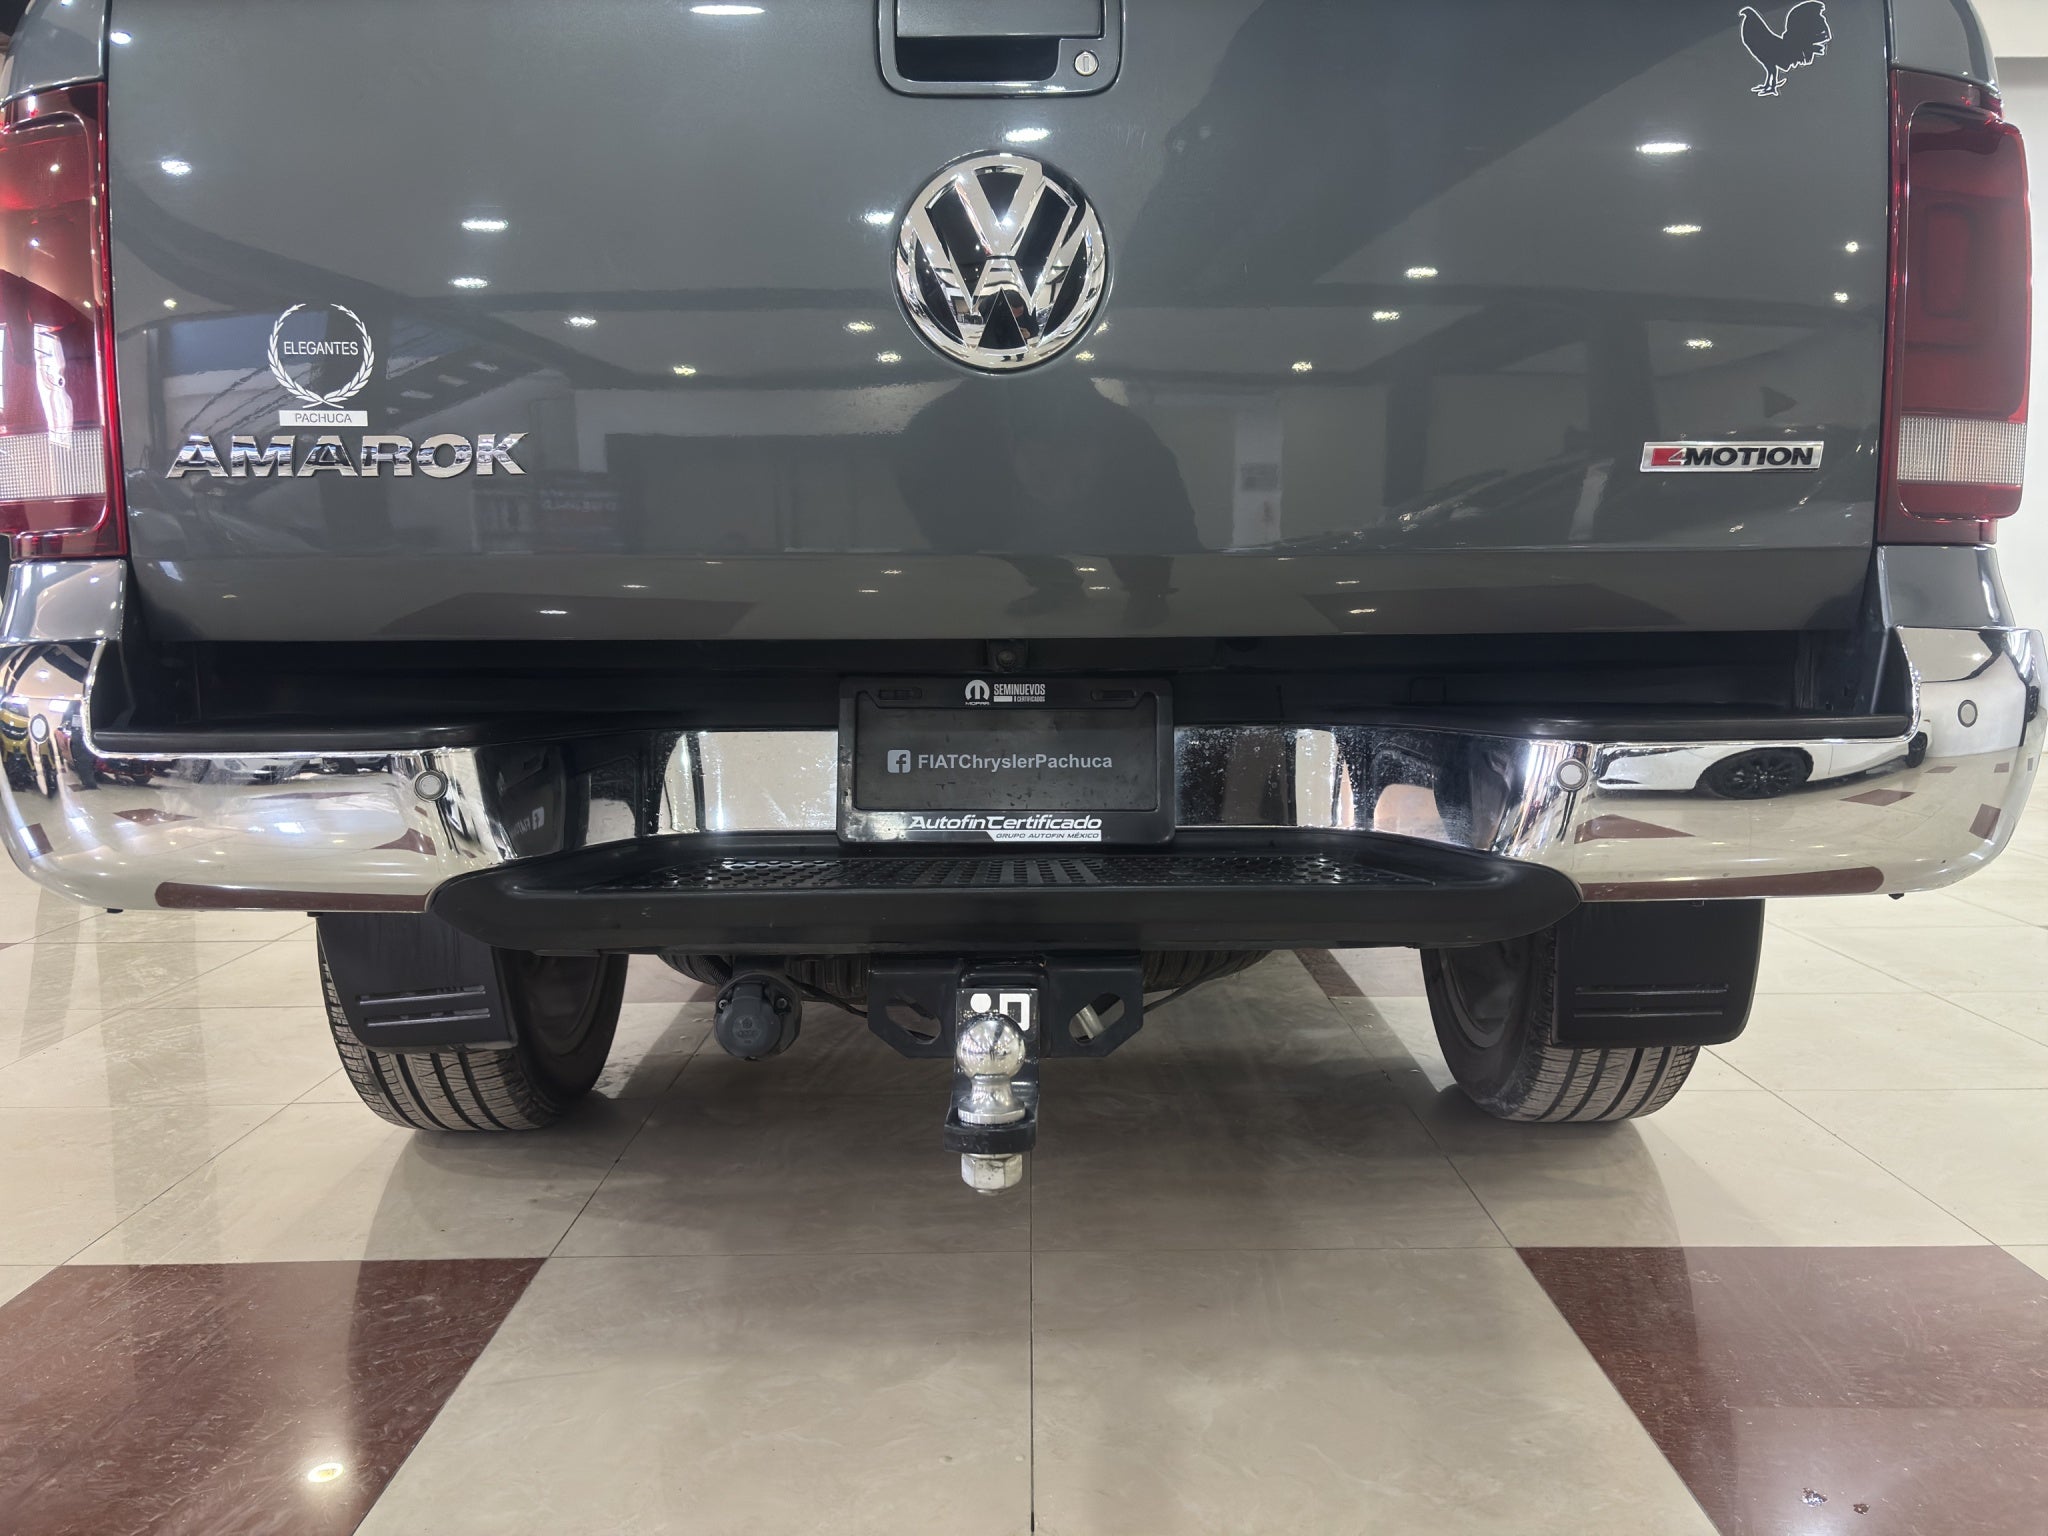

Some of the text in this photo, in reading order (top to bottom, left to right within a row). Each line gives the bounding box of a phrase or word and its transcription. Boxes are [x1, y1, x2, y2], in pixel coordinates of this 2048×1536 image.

[284, 341, 358, 356] ELEGANTES
[295, 411, 352, 424] PACHUCA
[165, 432, 529, 479] AMAROK
[1667, 447, 1814, 466] 4MOTION
[994, 684, 1046, 695] SEMINUEVOS
[918, 753, 1113, 772] FIATChryslerPachuca
[1066, 831, 1100, 839] MÉXICO
